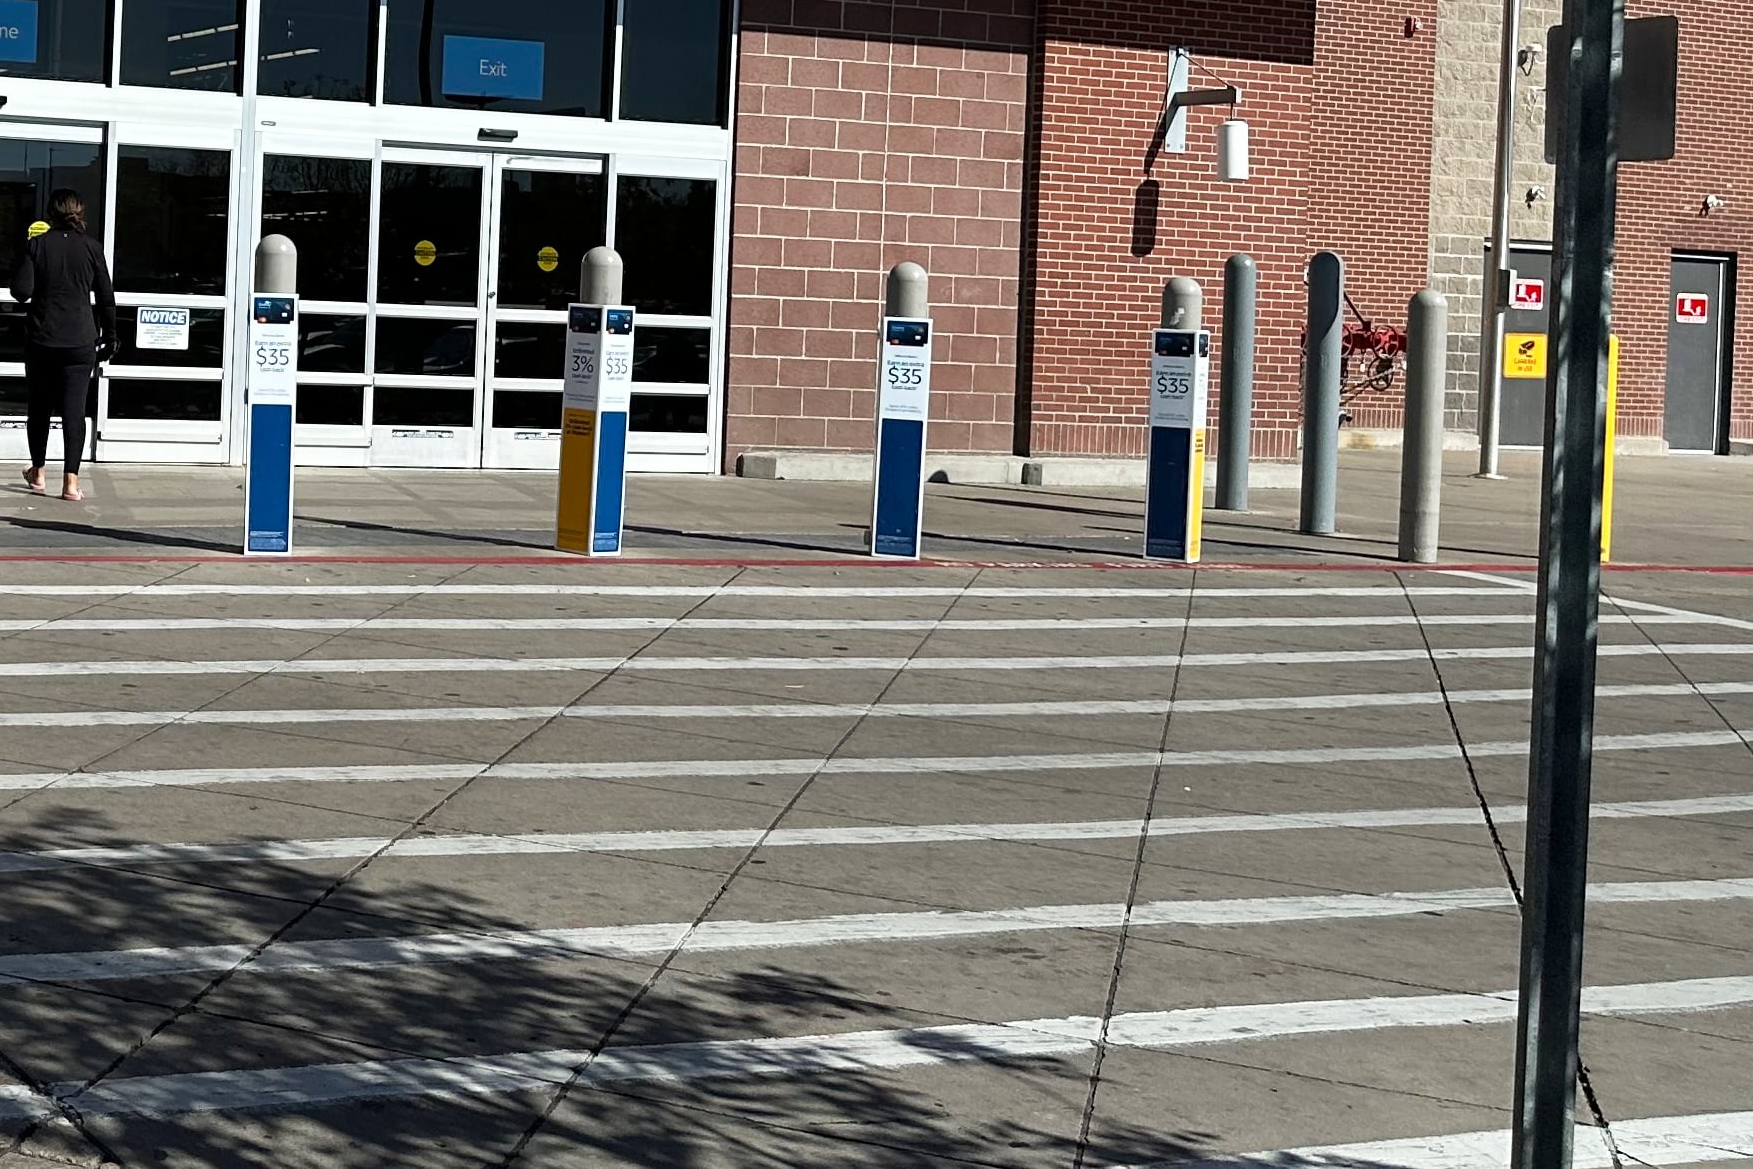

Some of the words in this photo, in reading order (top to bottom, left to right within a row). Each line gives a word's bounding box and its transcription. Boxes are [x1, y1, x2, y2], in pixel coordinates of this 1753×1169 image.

[479, 58, 507, 77] Exit
[141, 310, 186, 324] NOTICE
[256, 346, 289, 367] $35
[571, 355, 594, 373] 3%
[606, 356, 628, 375] $35
[888, 365, 922, 384] $35
[1157, 375, 1189, 394] $35
